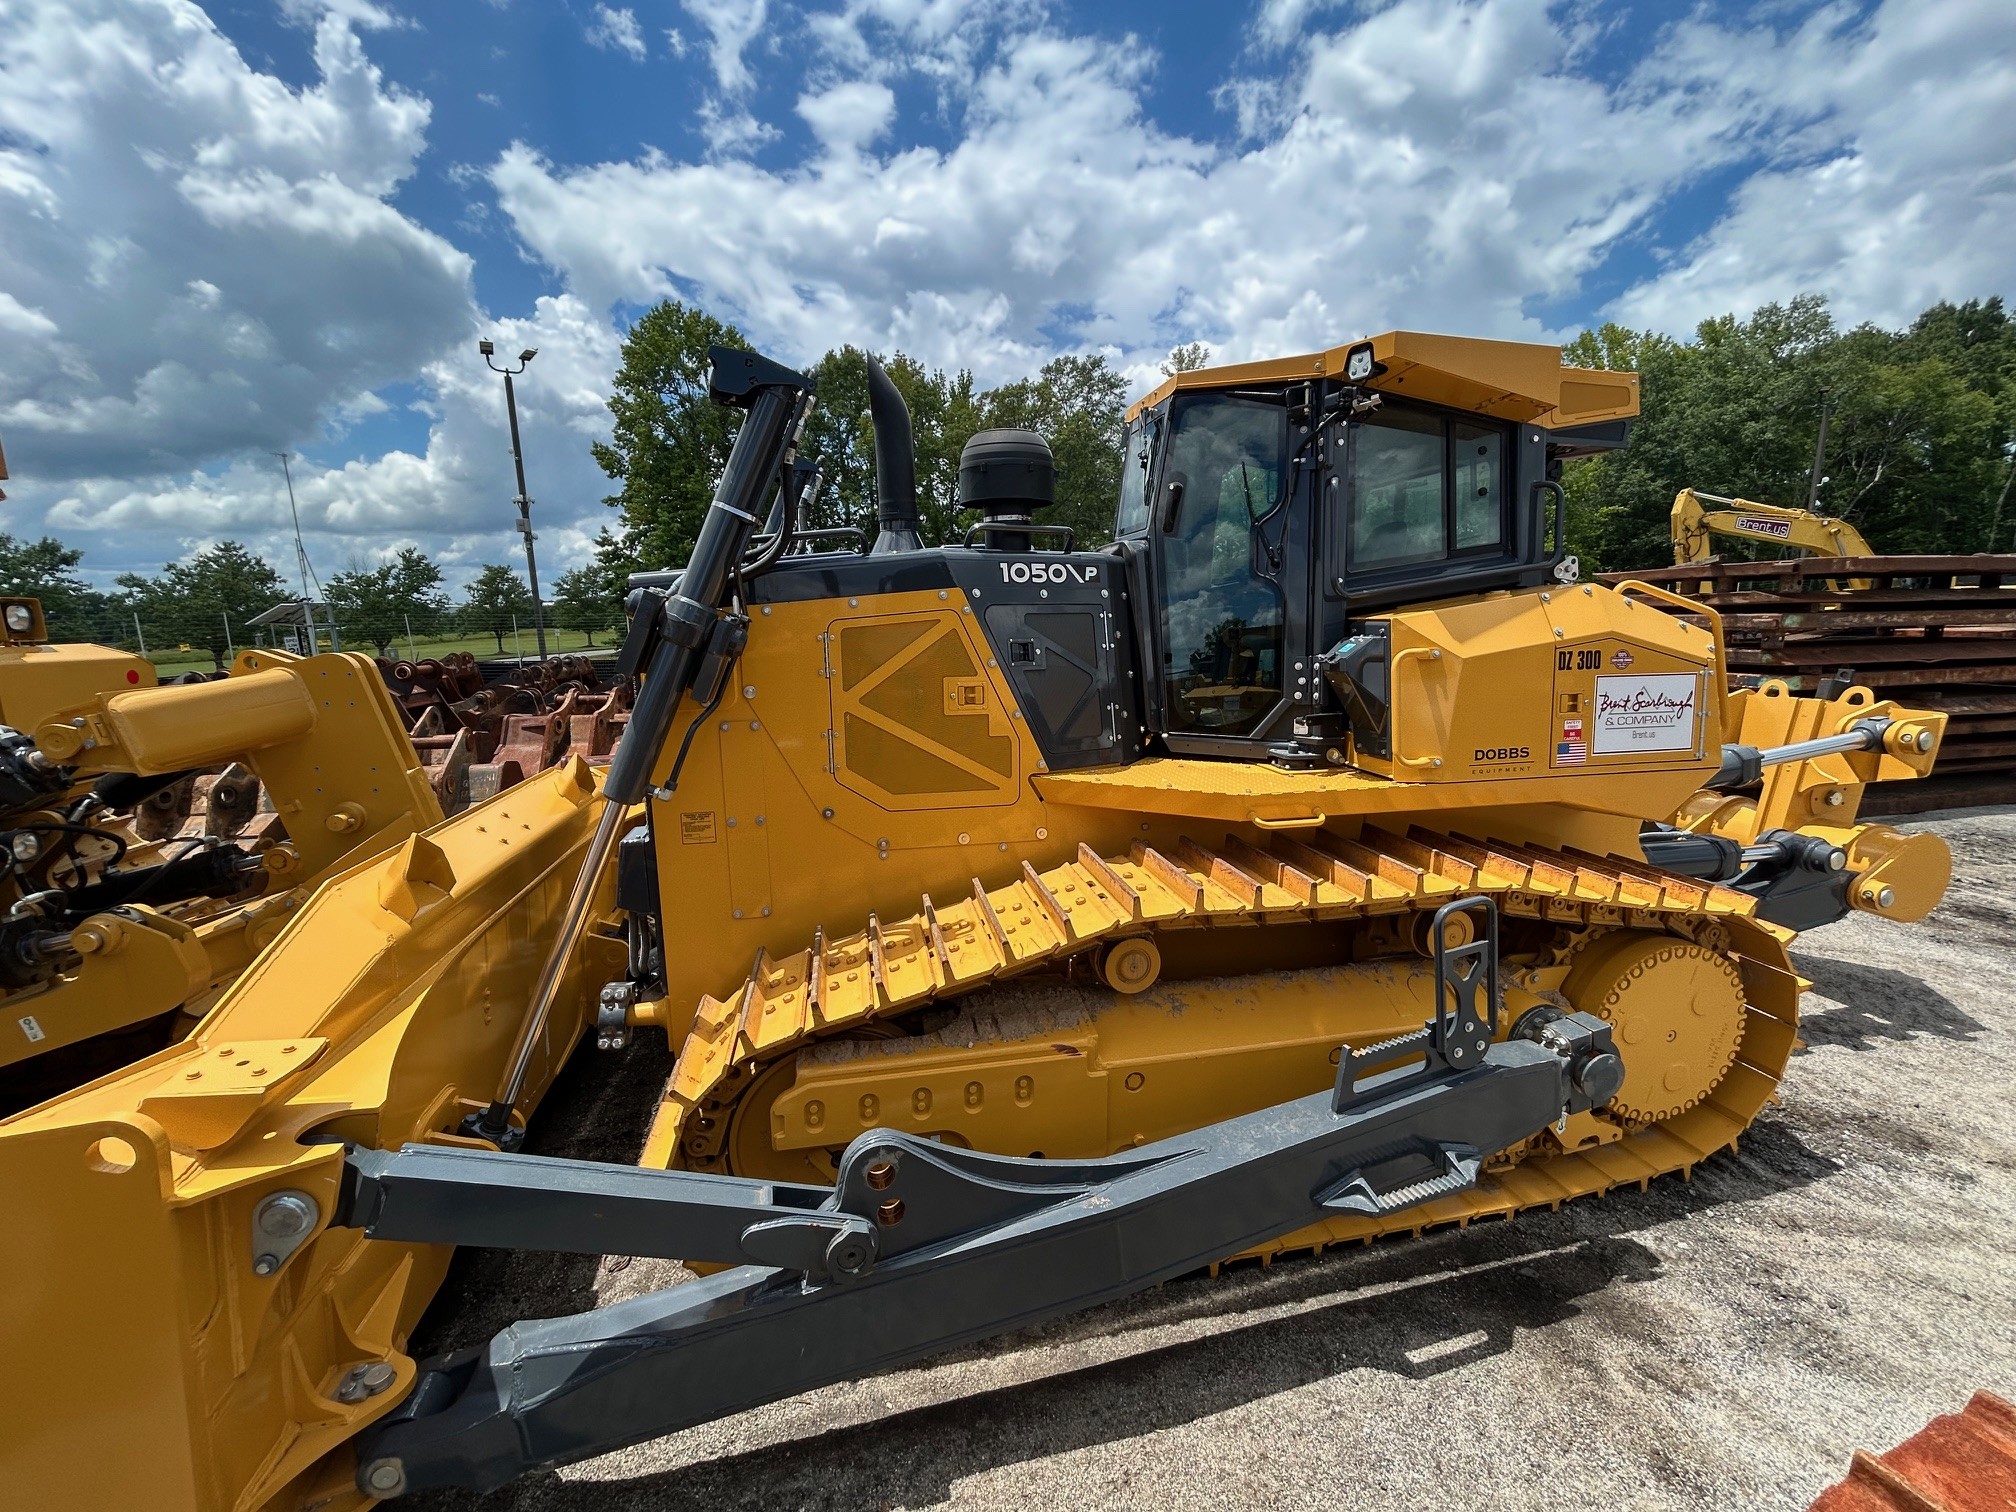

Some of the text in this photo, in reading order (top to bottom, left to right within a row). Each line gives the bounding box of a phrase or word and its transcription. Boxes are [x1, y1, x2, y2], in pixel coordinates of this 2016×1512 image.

[1738, 518, 1788, 536] Brent.us
[1558, 650, 1602, 671] DZ 300
[1598, 692, 1631, 720] Brent
[1605, 714, 1676, 726] & COMPANY
[1632, 730, 1656, 739] Brent.us
[1474, 747, 1530, 761] DOBBS
[1472, 766, 1531, 775] EQUIPMENT
